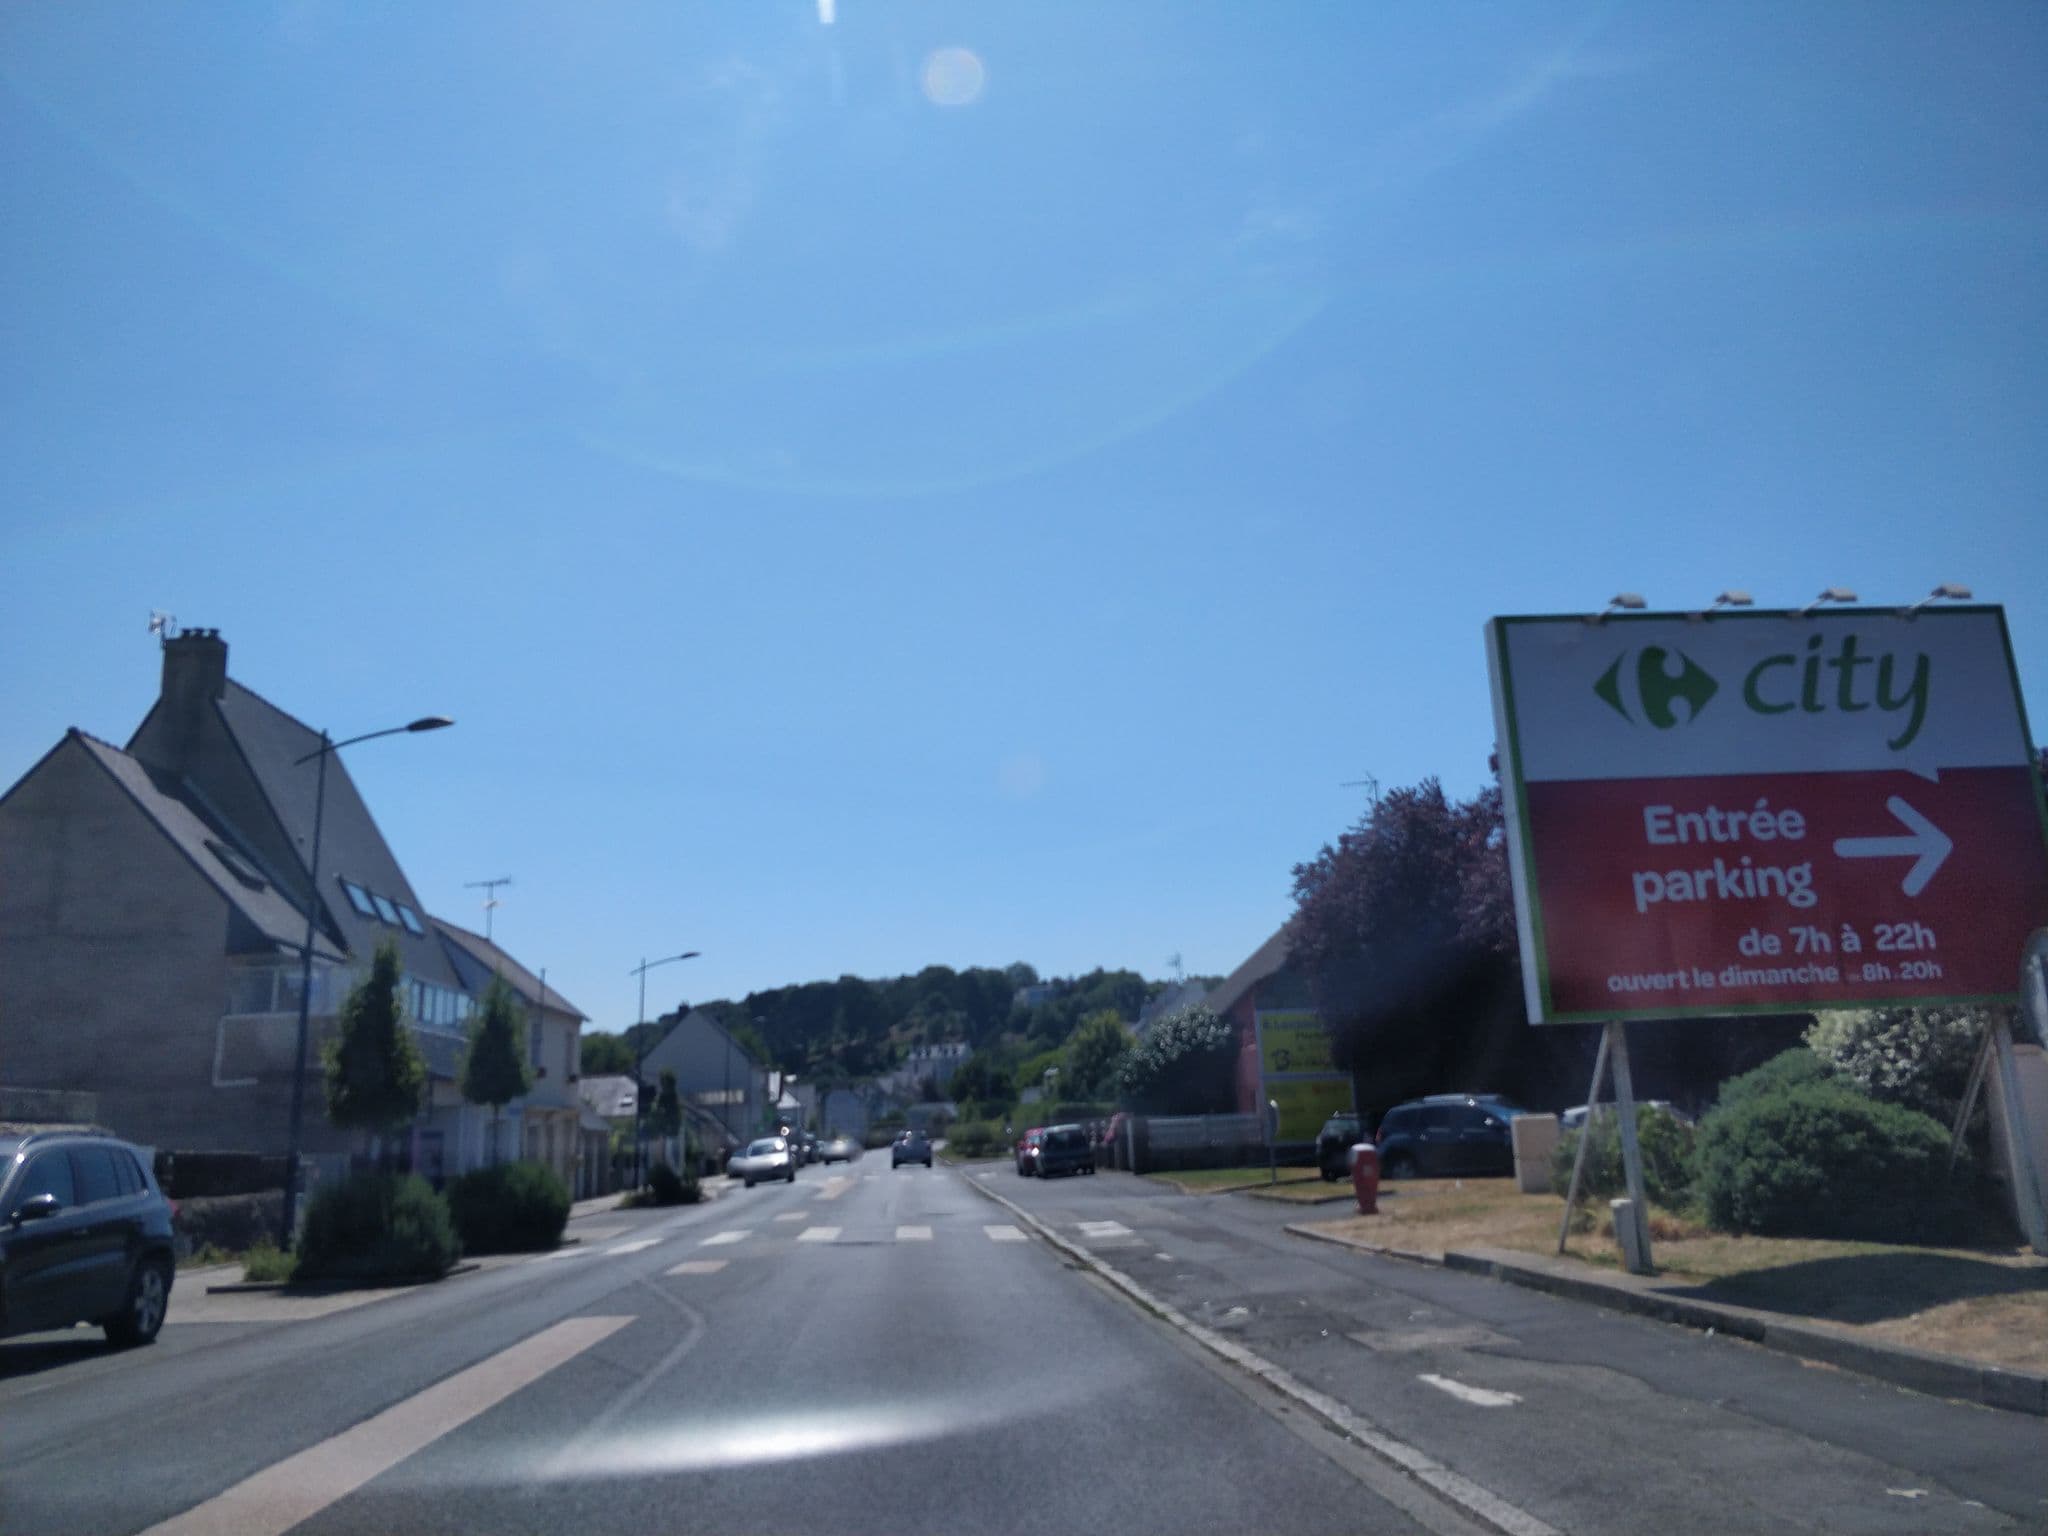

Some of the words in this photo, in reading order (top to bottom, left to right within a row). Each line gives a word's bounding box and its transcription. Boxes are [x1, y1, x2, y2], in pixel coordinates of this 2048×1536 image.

[1743, 633, 1931, 751] city
[1643, 798, 1806, 845] Entrée
[1631, 857, 1818, 913] parking
[1738, 927, 1782, 957] de
[1788, 925, 1832, 953] 7h
[1841, 922, 1862, 952] à
[1873, 921, 1937, 950] 22h
[1607, 969, 1690, 992] ouvert
[1693, 967, 1715, 988] le
[1719, 963, 1839, 988] dimanche
[1900, 960, 1943, 980] 20h
